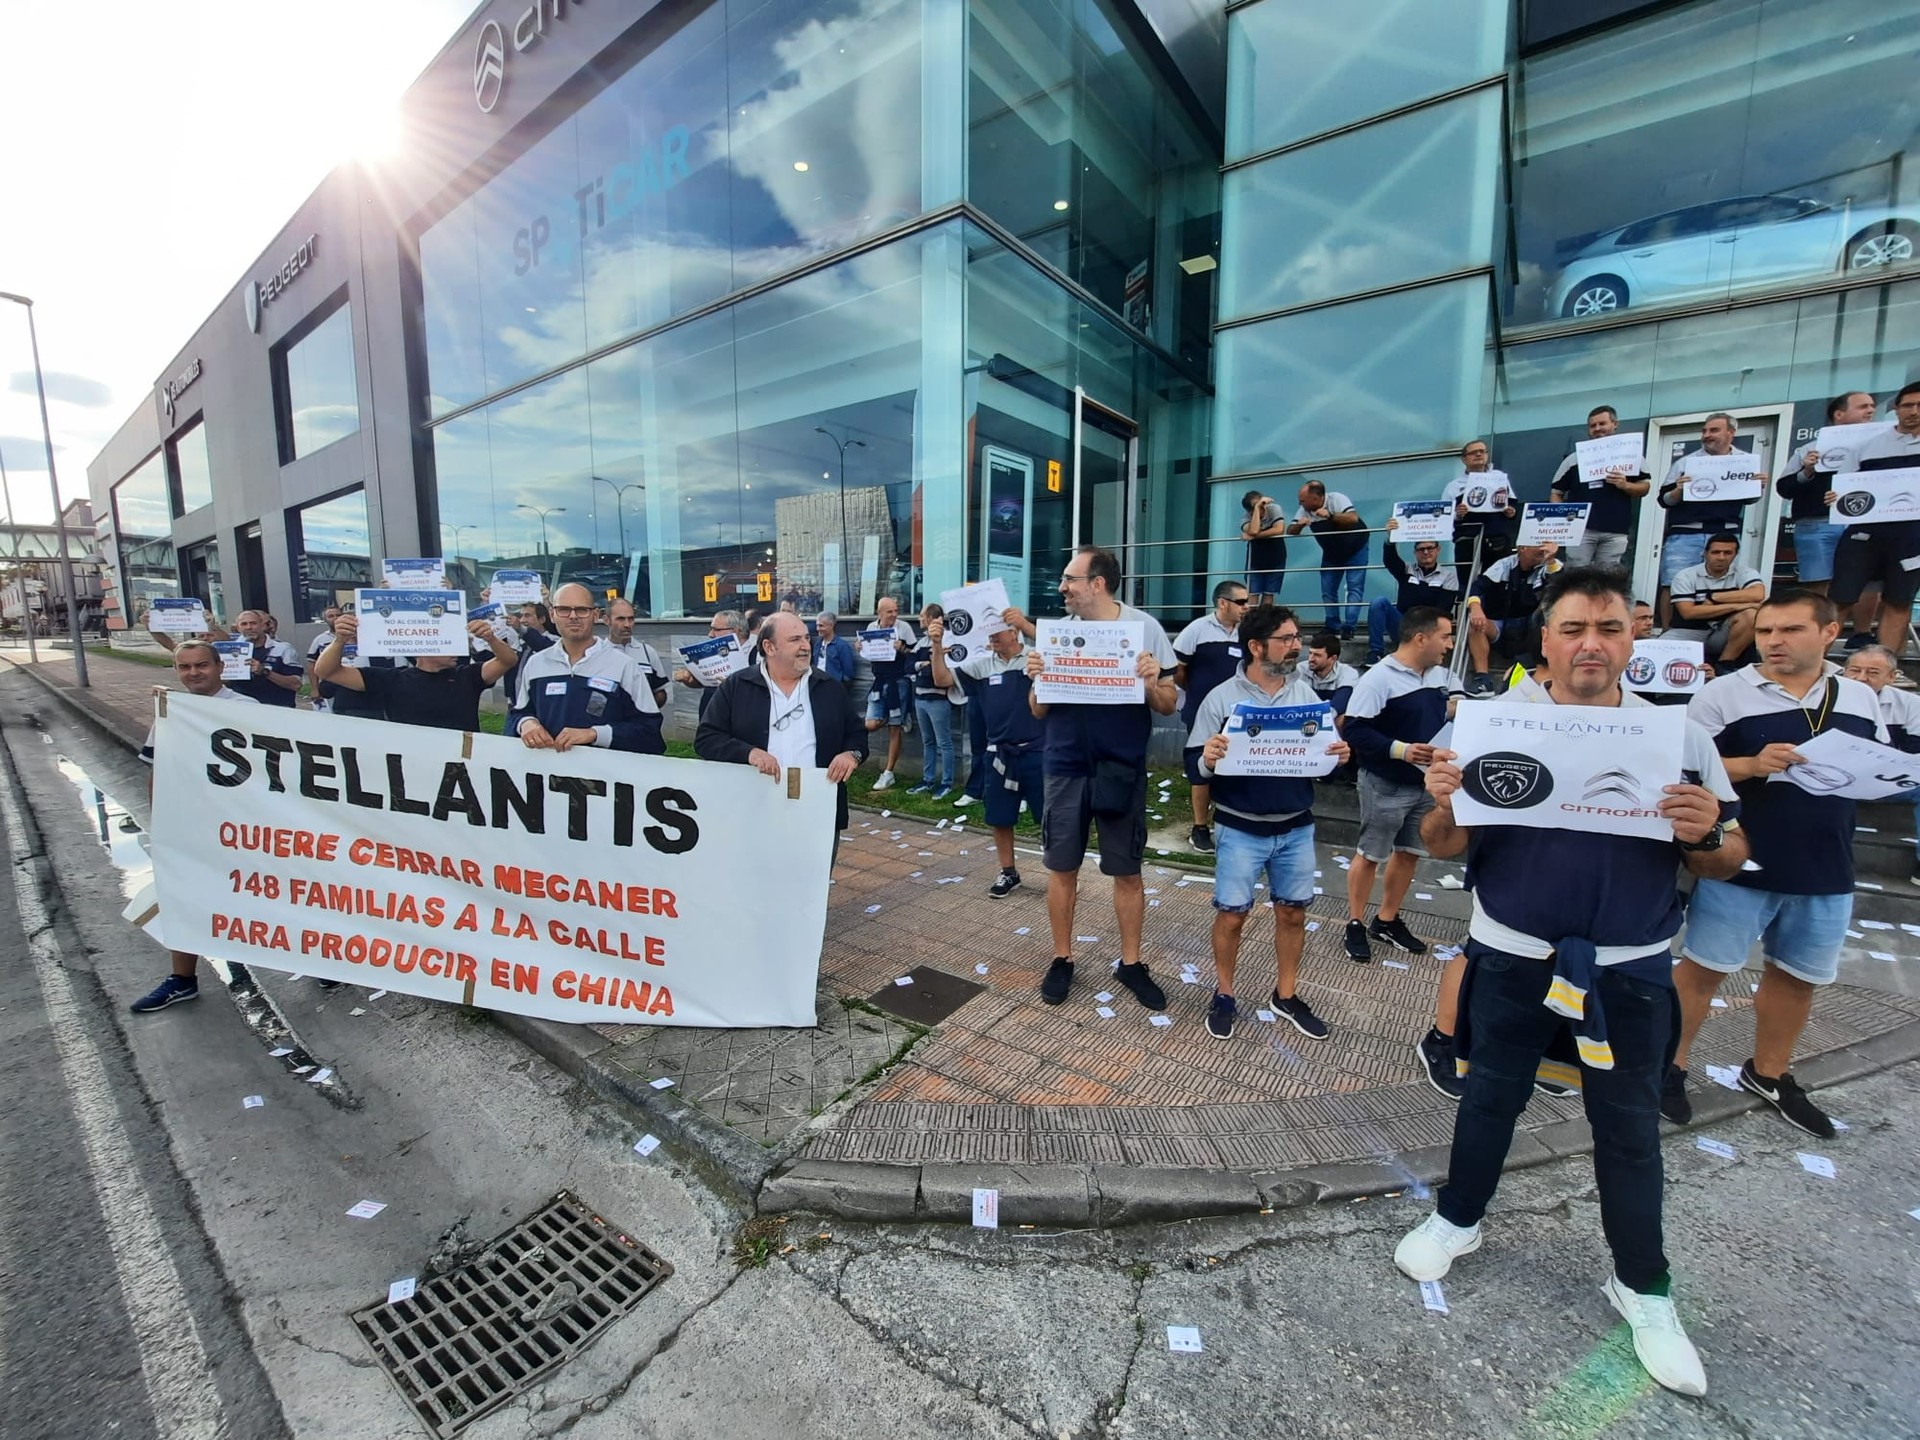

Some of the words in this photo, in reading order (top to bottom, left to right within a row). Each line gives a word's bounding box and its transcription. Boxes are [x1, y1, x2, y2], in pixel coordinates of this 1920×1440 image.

[260, 234, 317, 308] PEUGEOT
[1589, 464, 1633, 477] MECANER
[1720, 471, 1755, 481] Jeep
[375, 594, 446, 604] STELLANTIS
[387, 628, 439, 637] MECANER
[1048, 627, 1127, 637] STELLANTIS
[1054, 658, 1118, 668] STELLANTIS
[702, 665, 731, 677] MECANER
[1670, 667, 1691, 681] FIAT
[1040, 675, 1080, 683] CIERRA
[1081, 677, 1135, 687] MECANER
[1246, 710, 1322, 720] STELLANTIS
[1489, 717, 1645, 736] STELLANTIS
[1249, 747, 1306, 756] MECANER
[1484, 762, 1535, 772] PEUGEOT
[206, 727, 699, 855] STELLANTIS
[219, 821, 339, 862] QUIERE
[348, 837, 482, 887] CERRAR
[493, 864, 679, 918] MECANER
[228, 868, 281, 900] 148
[289, 879, 445, 928] FAMILIAS
[454, 904, 478, 932] A
[491, 907, 538, 941] LA
[548, 920, 666, 967] CALLE
[211, 913, 290, 952] PARA
[300, 928, 477, 982] PRODUCIR
[490, 958, 540, 993] EN
[551, 969, 675, 1017] CHINA
